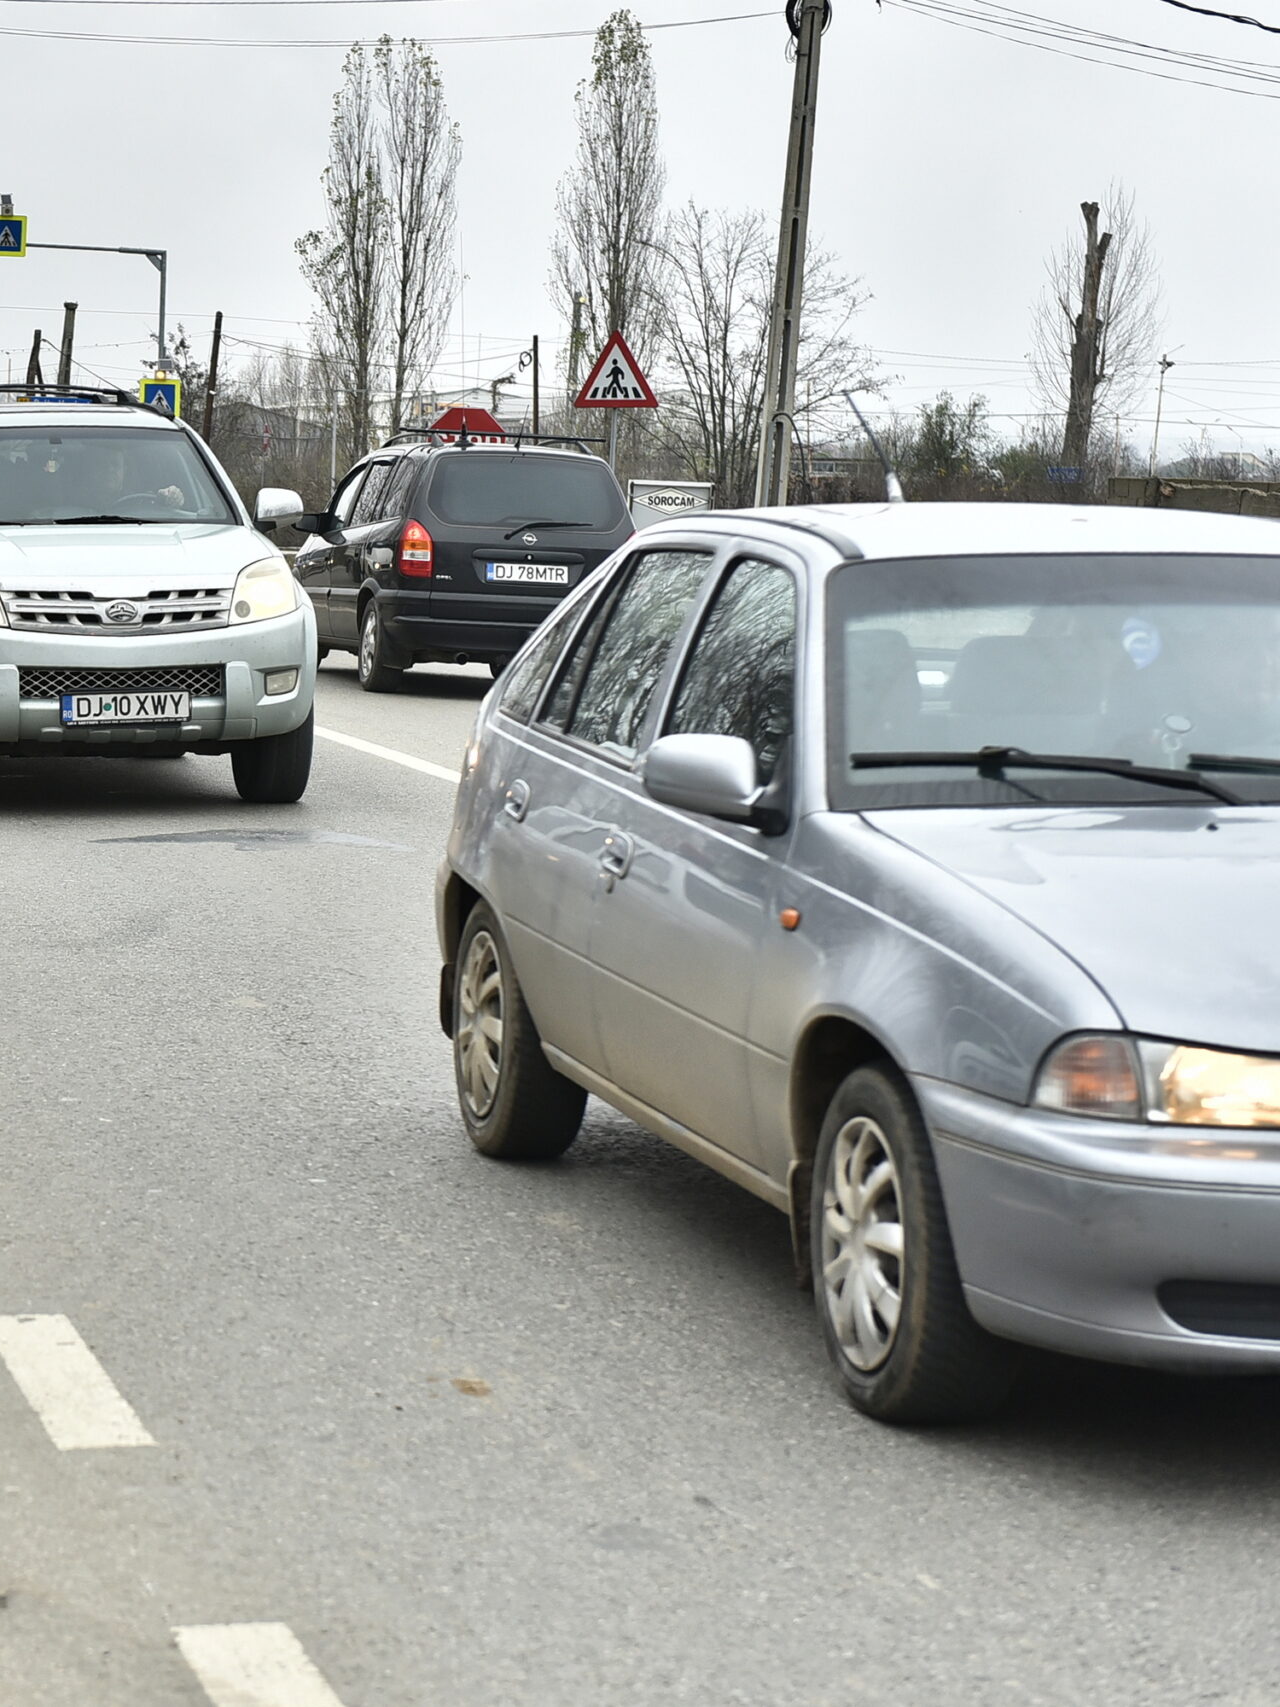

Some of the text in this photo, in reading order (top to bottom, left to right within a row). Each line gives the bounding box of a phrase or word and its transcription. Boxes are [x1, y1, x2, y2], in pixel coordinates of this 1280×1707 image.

[647, 495, 695, 508] SOROCAM
[495, 564, 513, 579] DJ
[76, 694, 183, 718] DJ 10 XWY
